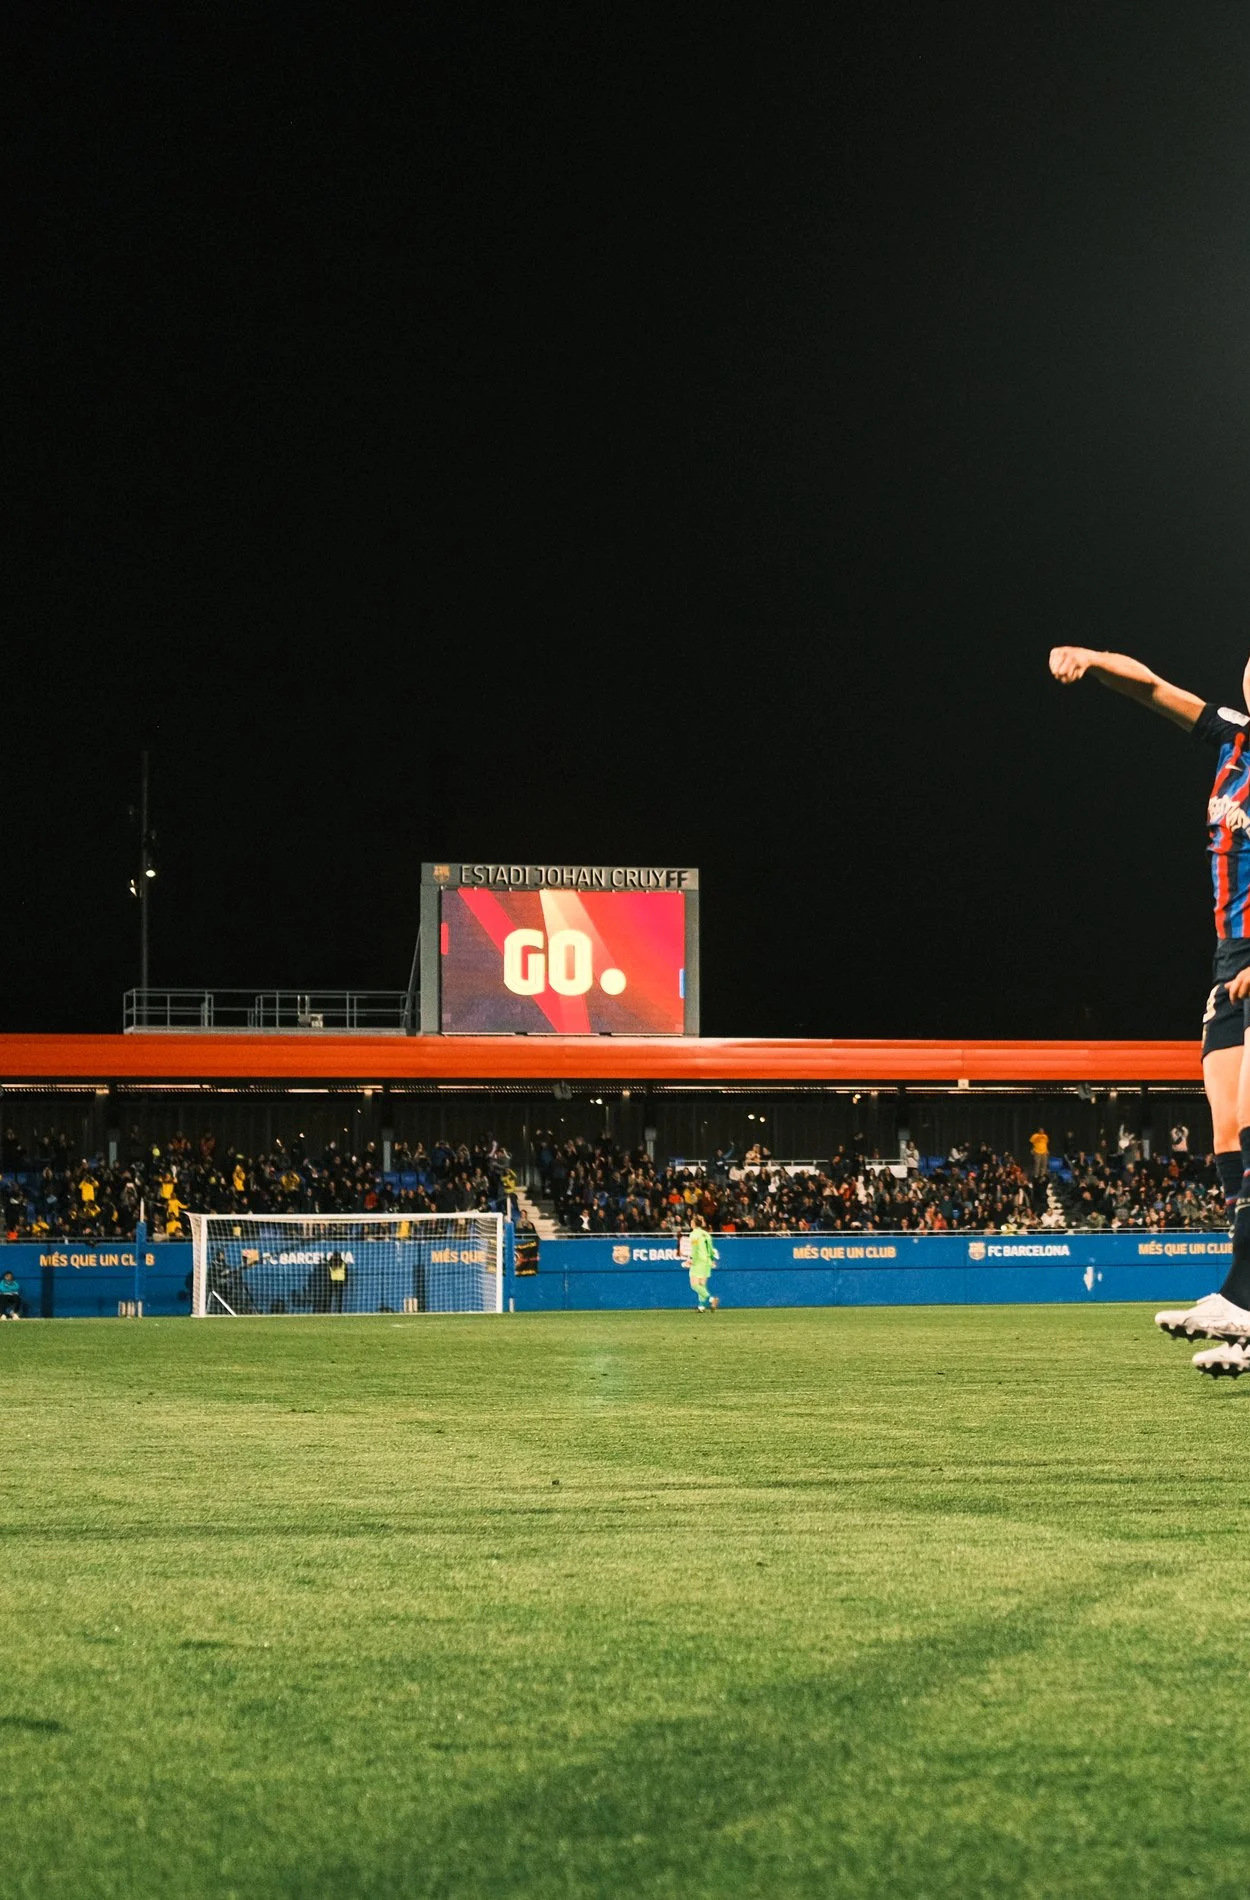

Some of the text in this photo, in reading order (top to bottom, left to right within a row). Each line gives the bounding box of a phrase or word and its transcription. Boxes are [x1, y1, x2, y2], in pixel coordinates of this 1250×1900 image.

[460, 864, 688, 889] ESTADI JOHAN CRUYFF
[503, 928, 627, 996] GO.
[632, 1248, 648, 1261] FC
[793, 1244, 896, 1261] MÉS QUE UN CLUB
[987, 1244, 1070, 1257] FC BARCELONA
[1138, 1240, 1163, 1255] MÉS
[1164, 1243, 1188, 1257] QUE
[1189, 1243, 1206, 1254] UN
[40, 1251, 155, 1269] MÉS QUE UN CLB
